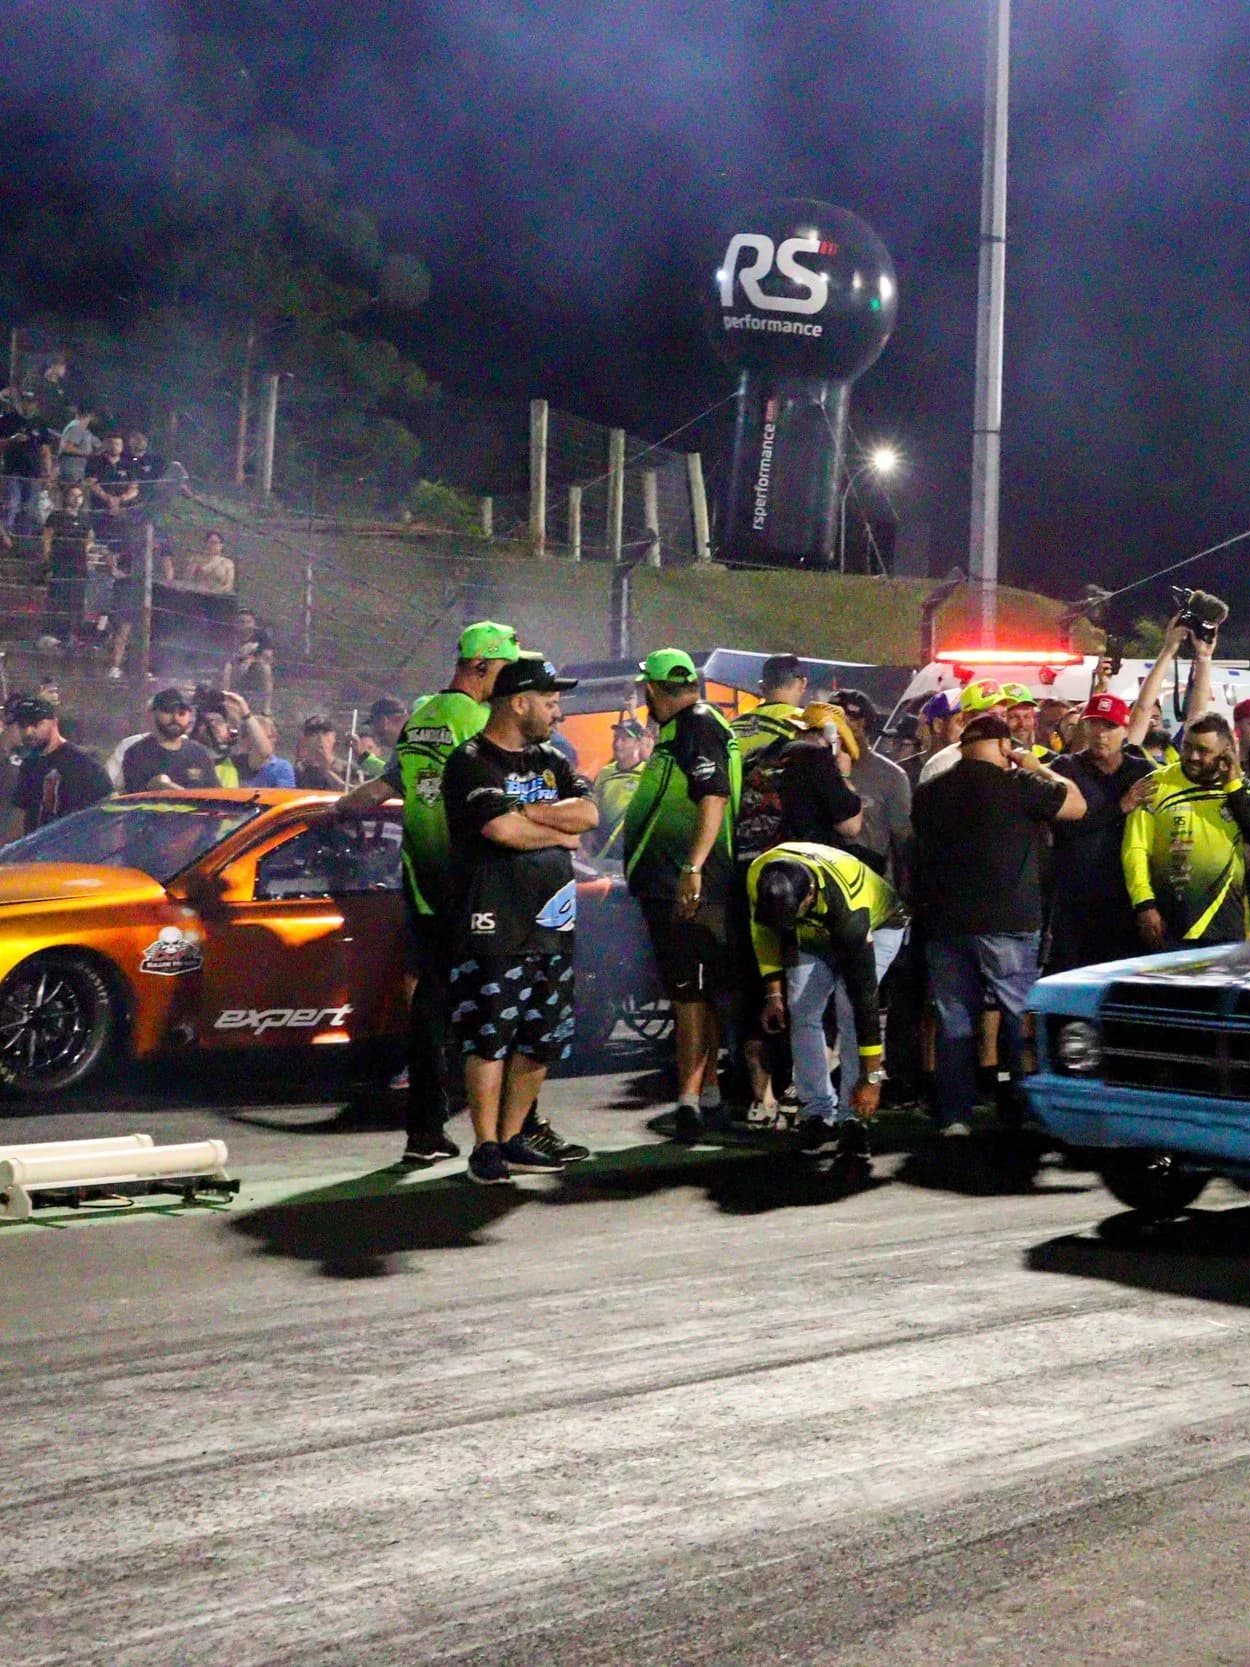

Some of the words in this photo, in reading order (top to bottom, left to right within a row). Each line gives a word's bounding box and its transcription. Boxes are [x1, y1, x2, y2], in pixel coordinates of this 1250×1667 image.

[720, 233, 829, 315] RS
[723, 313, 823, 338] performance
[471, 911, 497, 932] RS
[213, 1003, 354, 1036] expert
